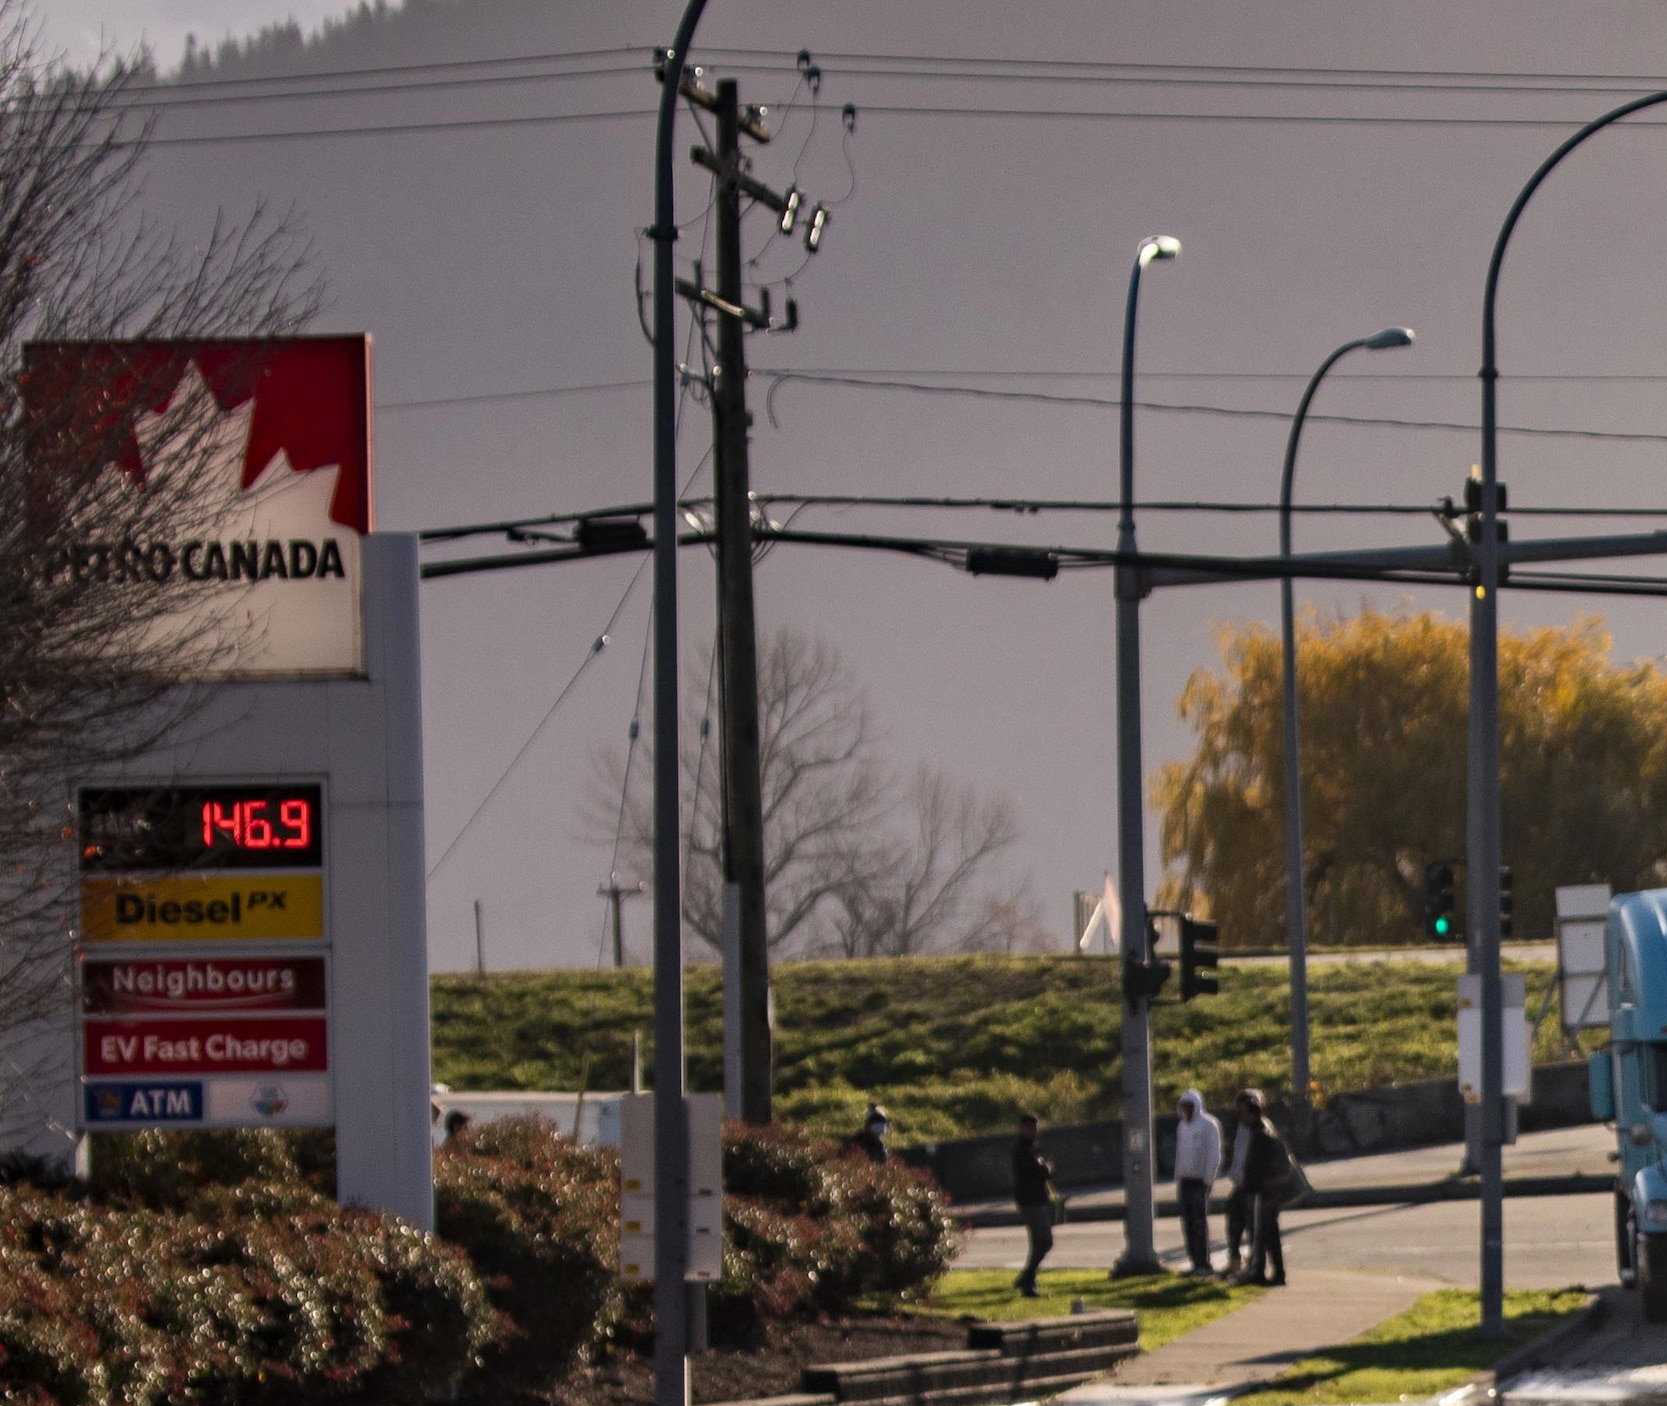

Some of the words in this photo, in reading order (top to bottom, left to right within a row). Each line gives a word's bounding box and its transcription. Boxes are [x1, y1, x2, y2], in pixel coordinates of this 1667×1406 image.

[180, 538, 346, 581] CANADA
[202, 801, 311, 849] 146.9
[115, 891, 241, 925] Diesel
[246, 890, 287, 910] PX
[113, 963, 296, 998] Neighbours
[101, 1036, 138, 1062] EV
[144, 1035, 200, 1061] Fast
[205, 1034, 308, 1066] Charge
[130, 1089, 190, 1117] ATM
